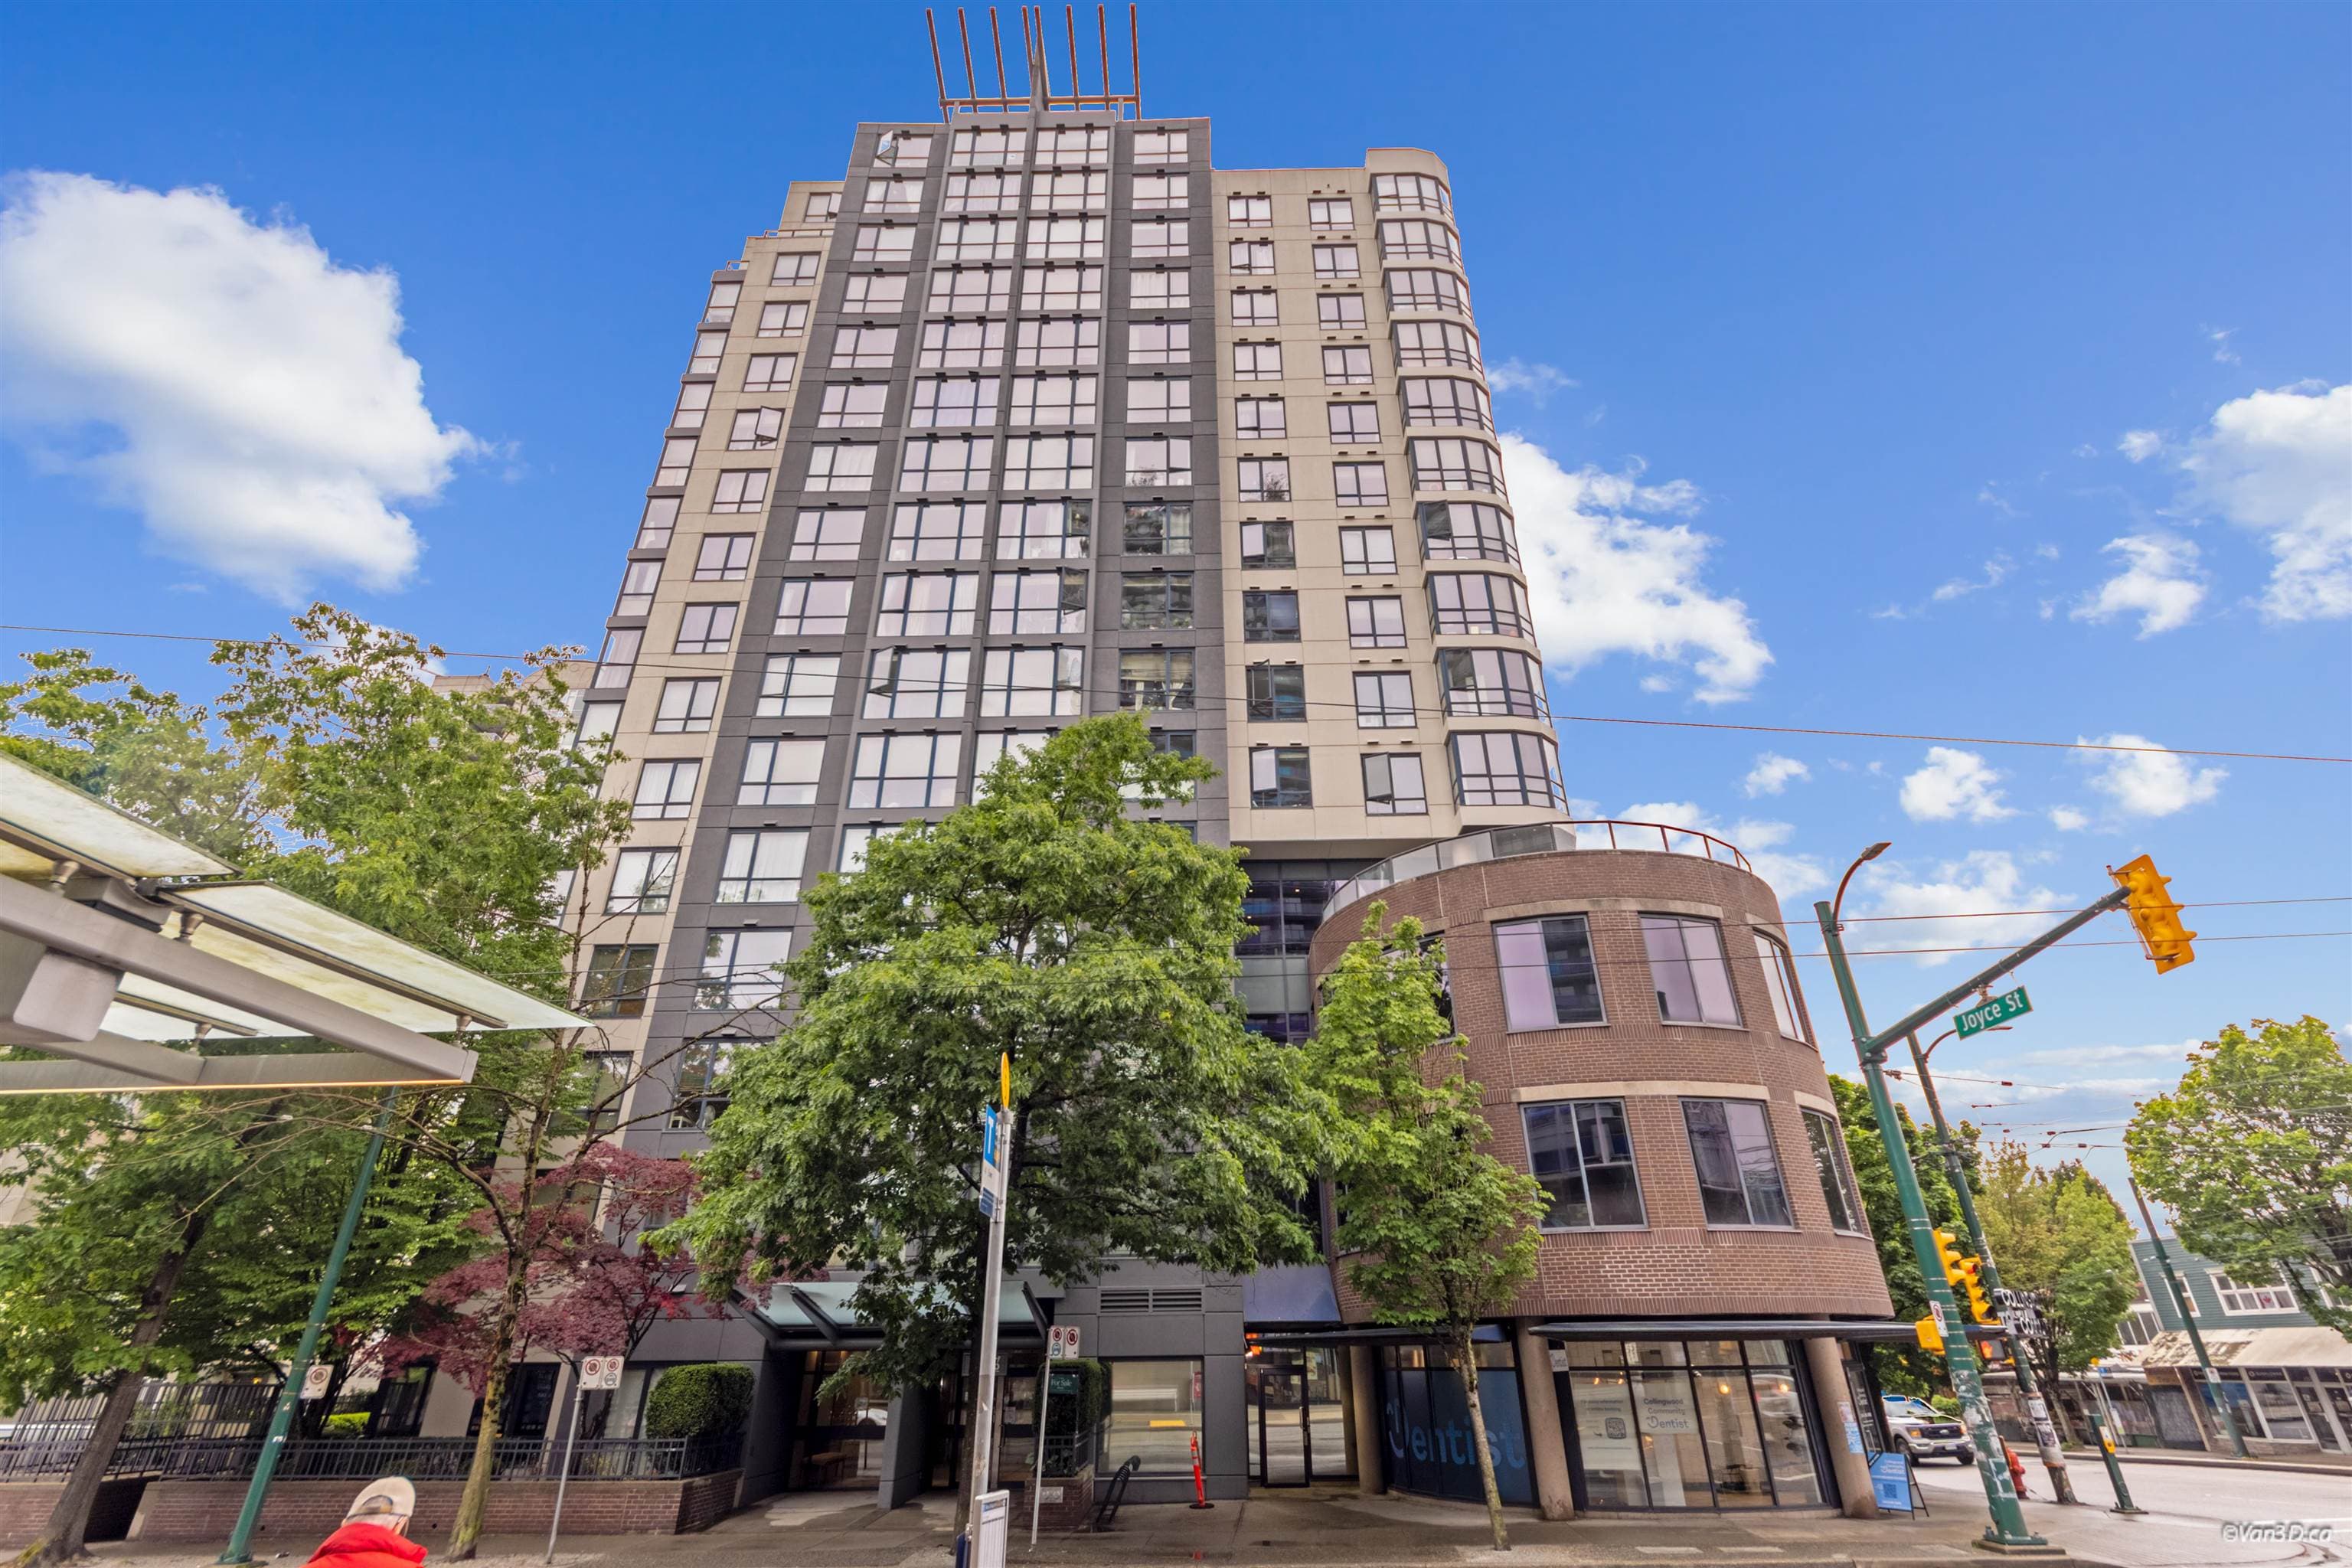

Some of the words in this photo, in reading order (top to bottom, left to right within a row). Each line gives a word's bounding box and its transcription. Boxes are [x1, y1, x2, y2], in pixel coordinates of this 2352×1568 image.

[1962, 1002, 2002, 1032] Joyce
[2005, 991, 2024, 1012] St
[1051, 1378, 1060, 1387] For
[1060, 1378, 1073, 1387] Sale
[1643, 1397, 1684, 1406] Collingwood
[1648, 1407, 1686, 1416] Community
[1645, 1415, 1690, 1429] Dentist
[1386, 1398, 1526, 1469] Dentist
